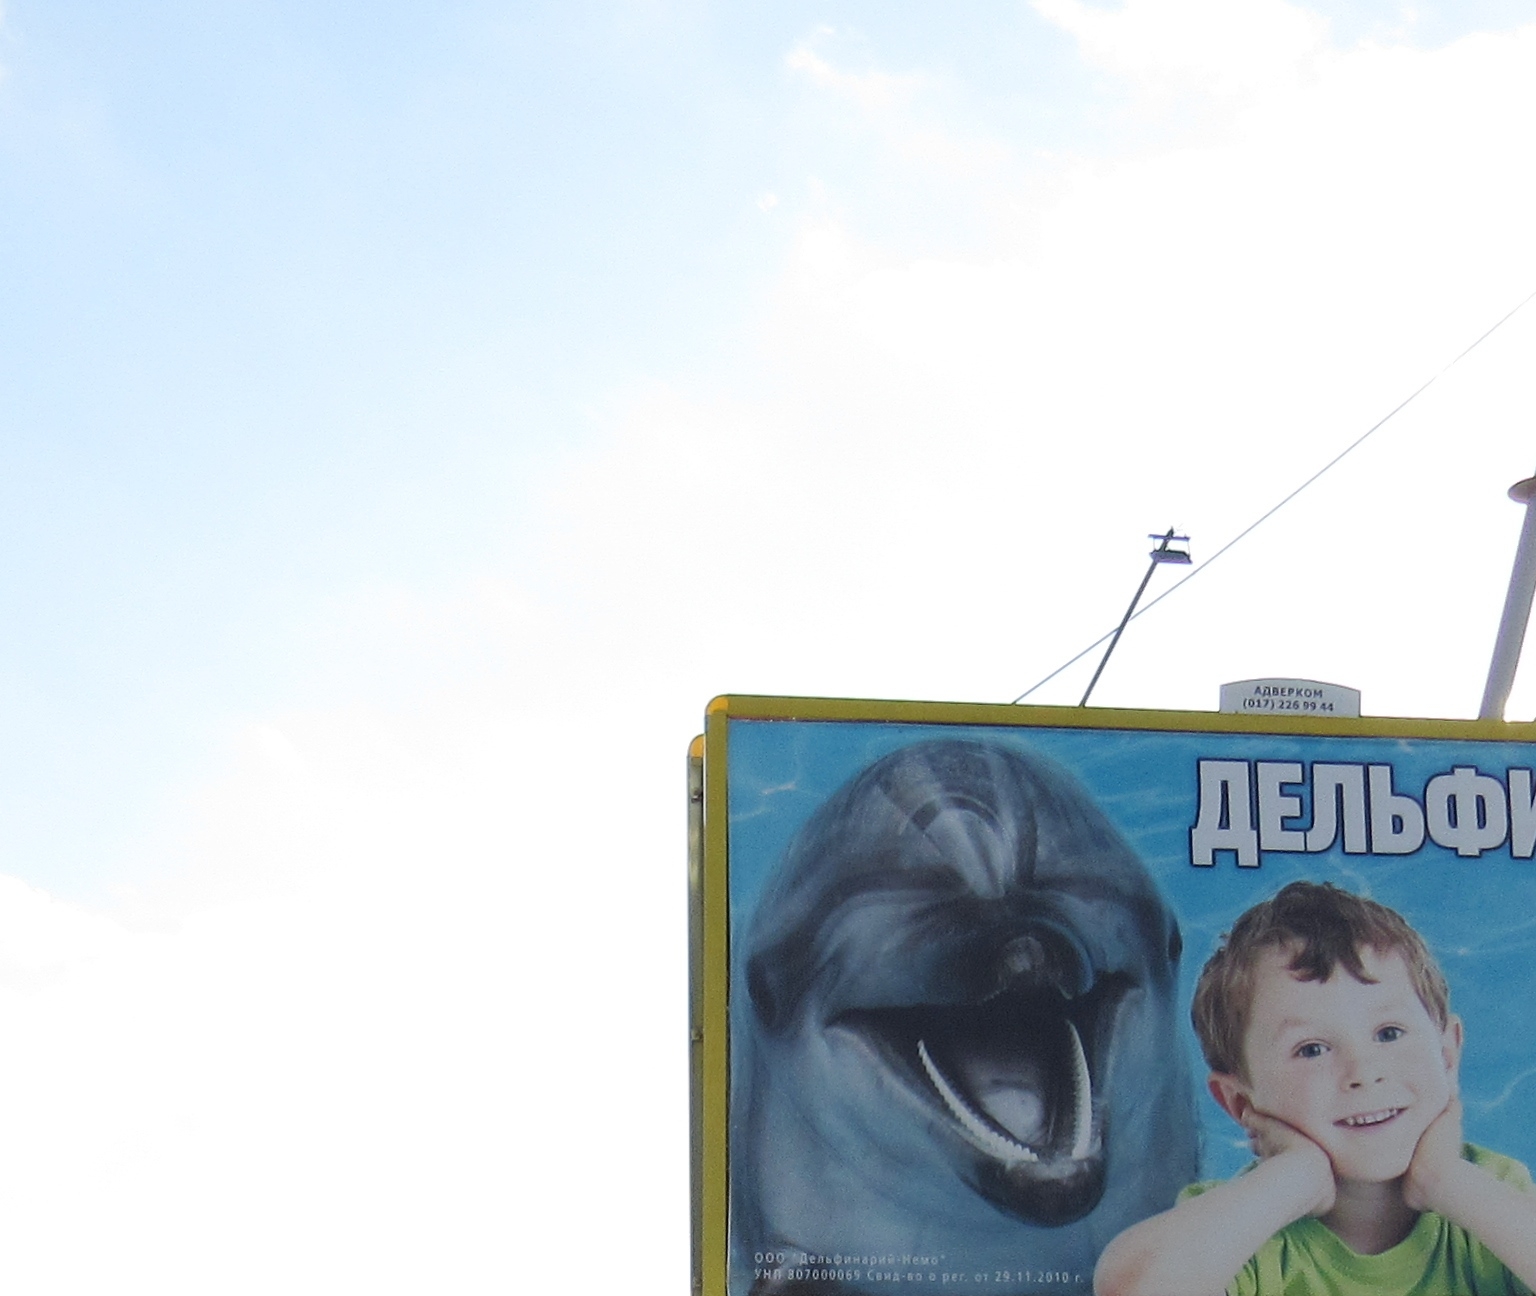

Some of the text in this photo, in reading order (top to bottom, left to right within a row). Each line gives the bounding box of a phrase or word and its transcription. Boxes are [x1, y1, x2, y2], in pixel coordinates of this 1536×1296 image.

[1254, 685, 1323, 699] АДВЕРКОМ
[1242, 698, 1334, 712] (017) 226 99 44
[753, 1252, 785, 1265] ООО
[753, 1268, 783, 1281] УНП
[787, 1269, 861, 1281] 807000069
[866, 1270, 922, 1283] Свид-во
[928, 1273, 937, 1283] о
[942, 1272, 969, 1285] рег.
[974, 1273, 989, 1283] от
[994, 1271, 1070, 1284] 29.11.2010
